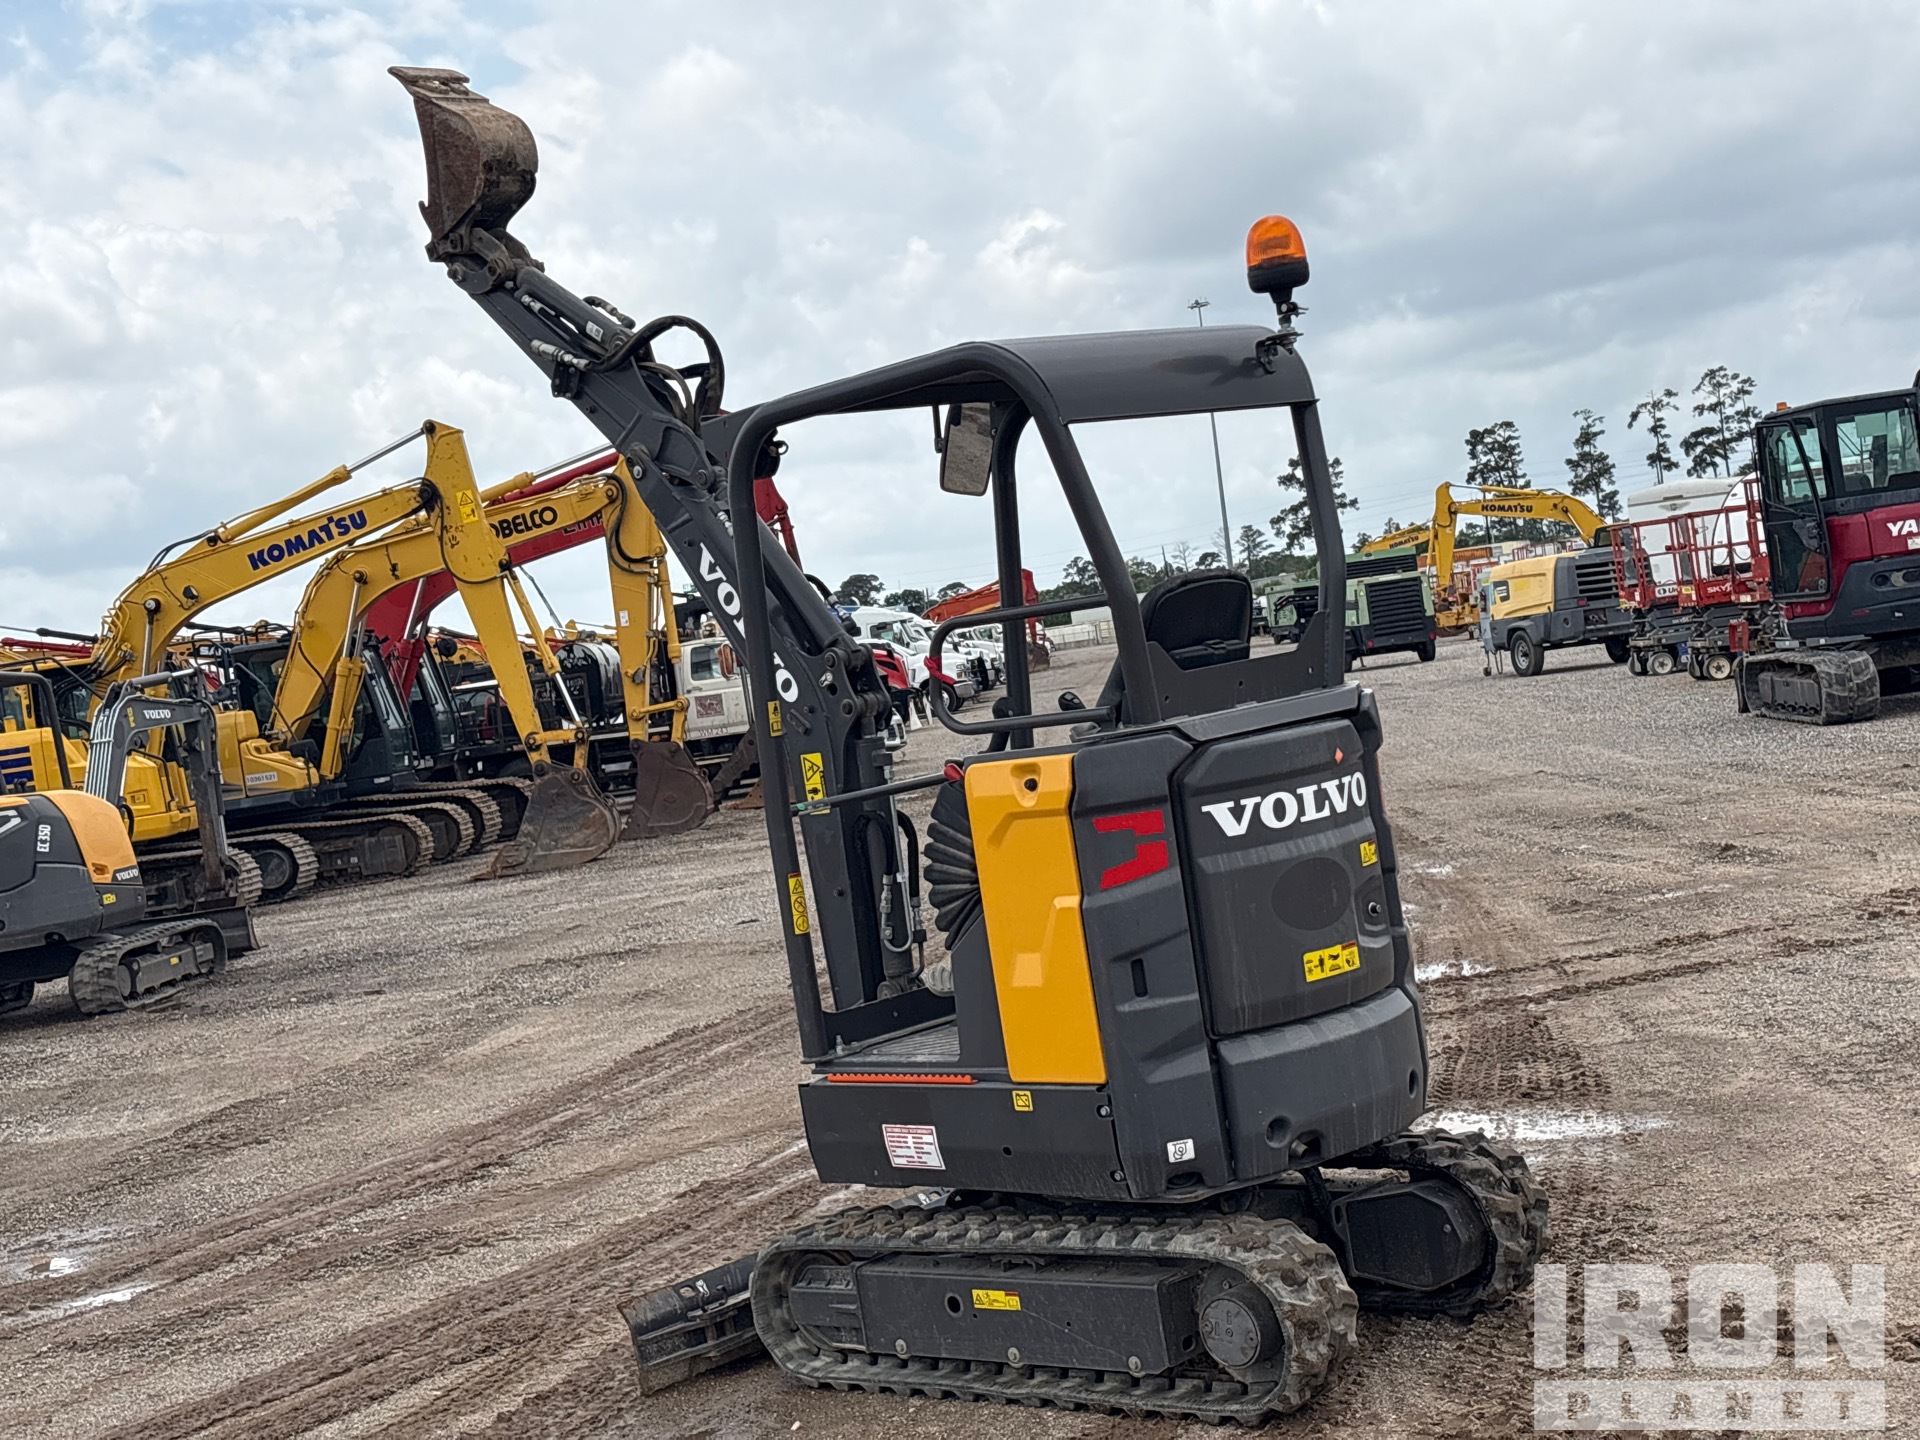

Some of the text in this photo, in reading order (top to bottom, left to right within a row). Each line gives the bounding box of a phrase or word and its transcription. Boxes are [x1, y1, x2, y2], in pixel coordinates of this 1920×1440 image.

[1481, 502, 1533, 513] KOMATSU
[247, 509, 368, 571] KOMATSU
[1389, 535, 1419, 549] KOMATSU
[143, 709, 171, 719] VOLVO
[1201, 771, 1367, 837] VOLVO
[115, 868, 139, 881] VOLVO
